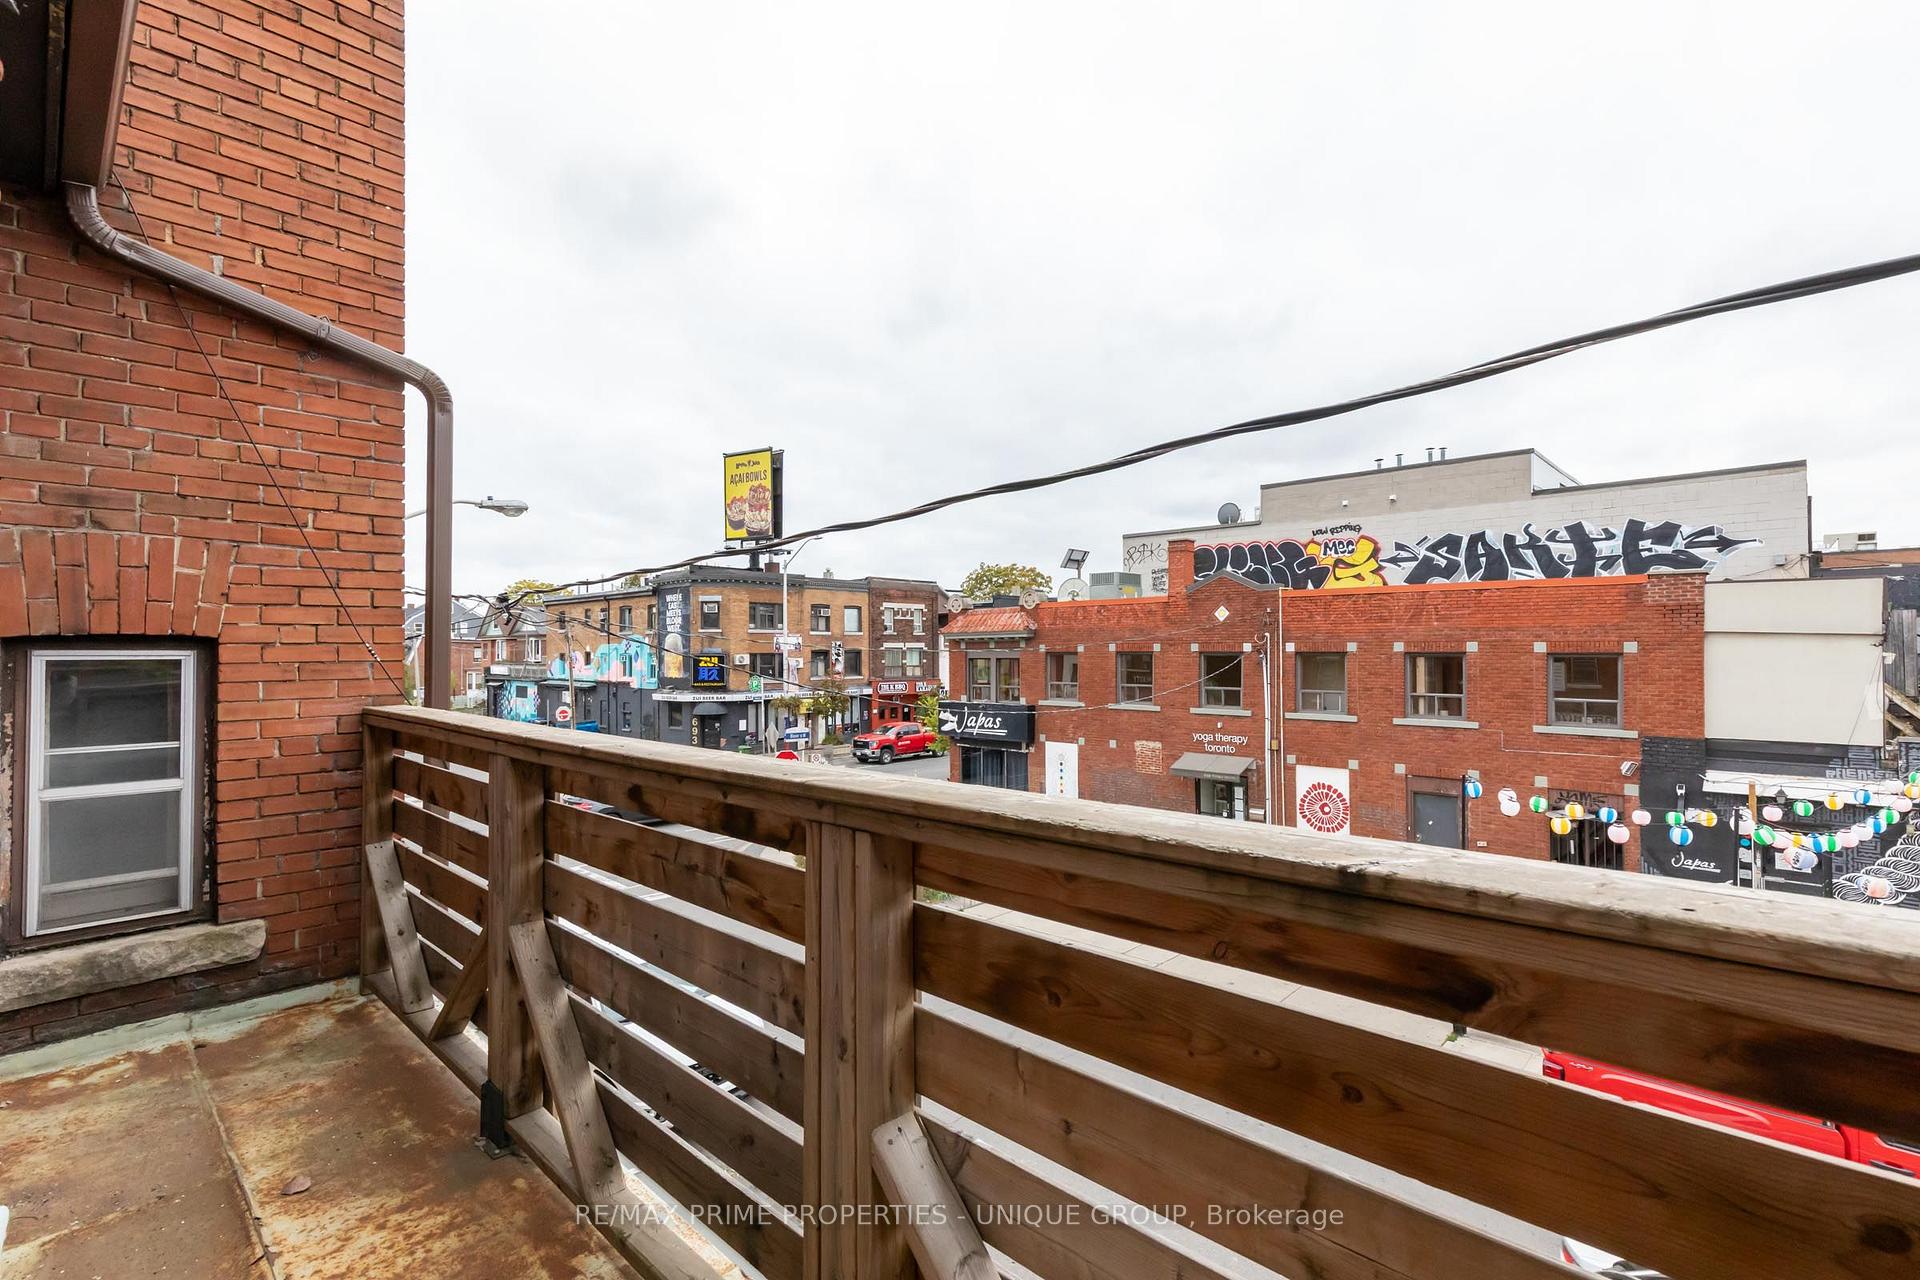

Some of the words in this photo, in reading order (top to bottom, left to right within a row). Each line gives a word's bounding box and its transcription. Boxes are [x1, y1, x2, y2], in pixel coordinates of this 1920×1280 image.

[746, 470, 767, 482] BOWLS
[955, 706, 1002, 736] Japas
[1192, 733, 1213, 742] yoga
[1215, 733, 1248, 745] therapy
[1204, 743, 1235, 753] toronto
[1671, 851, 1716, 870] Japas
